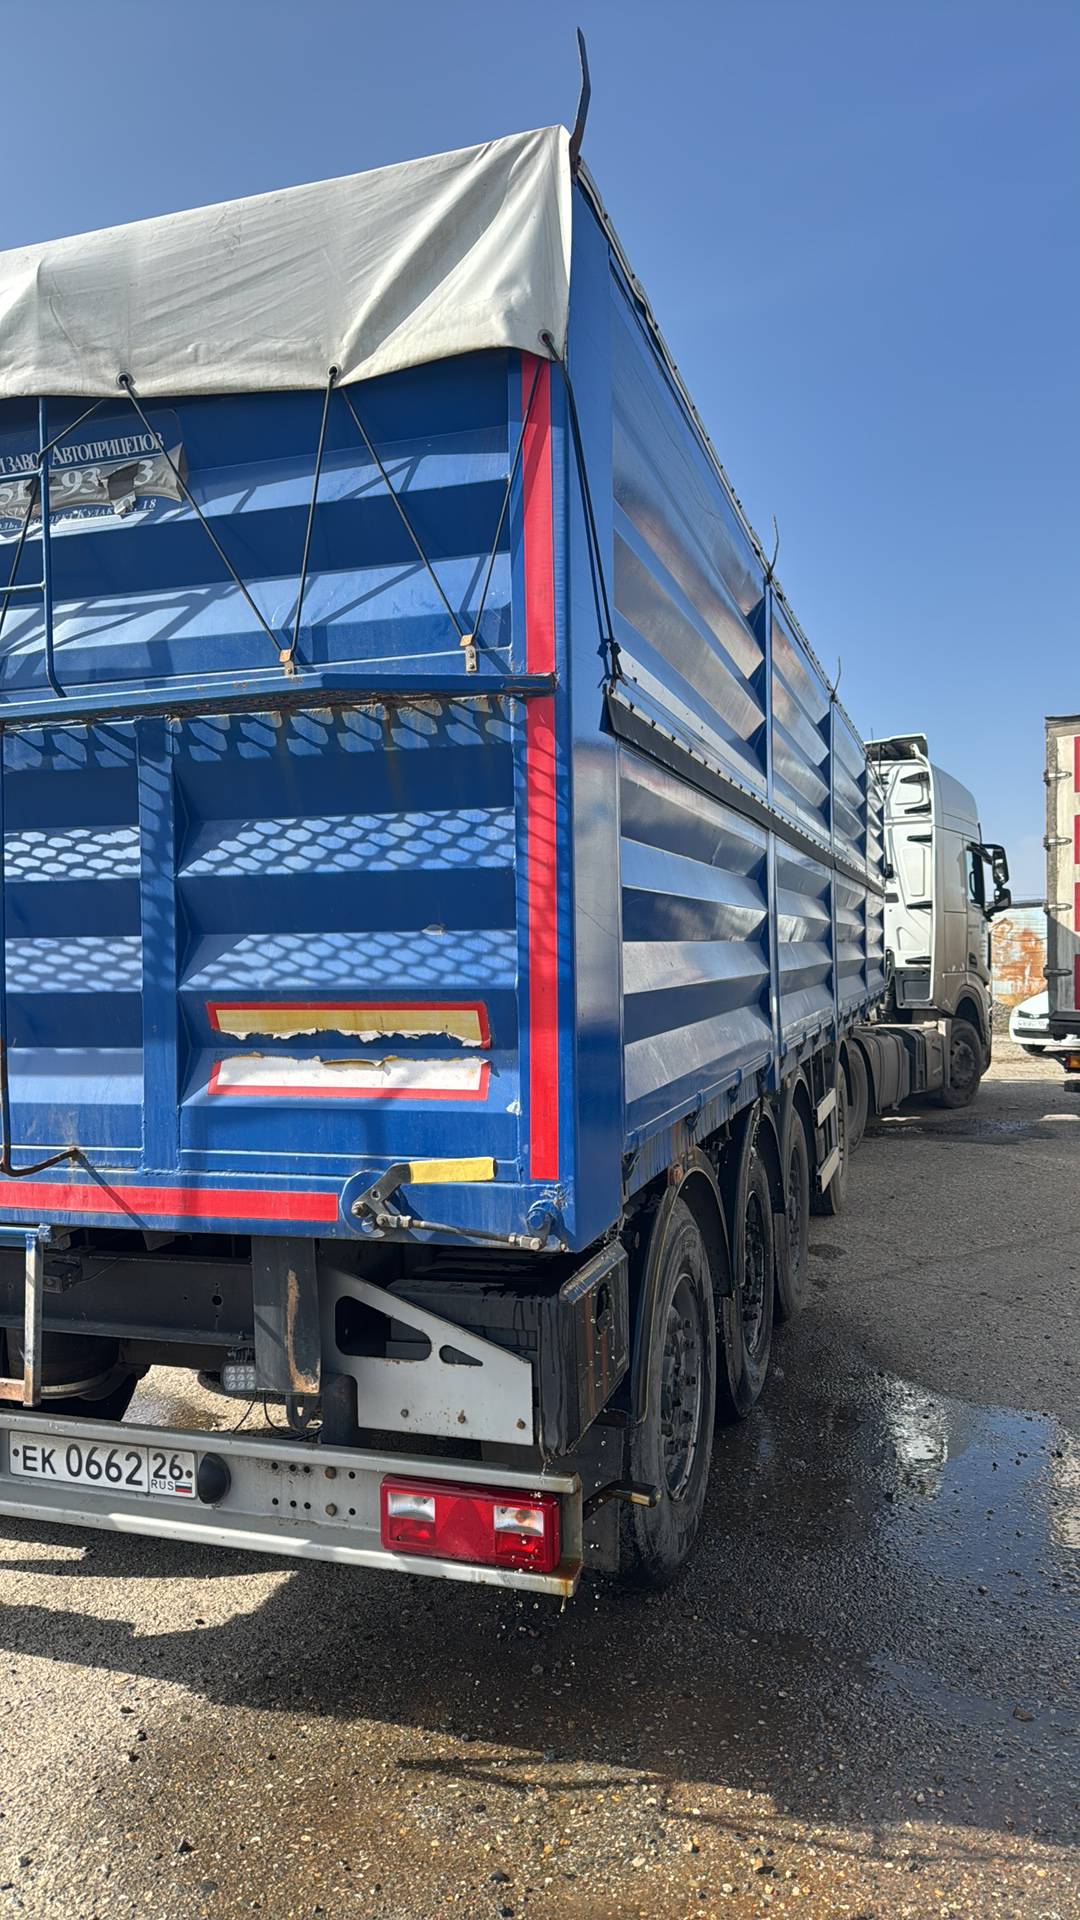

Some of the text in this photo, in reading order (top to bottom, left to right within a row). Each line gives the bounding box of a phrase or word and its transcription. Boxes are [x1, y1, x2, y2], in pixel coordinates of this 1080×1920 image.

[142, 498, 157, 510] 18
[22, 1443, 184, 1487] ЕК 0662 26
[150, 1478, 175, 1491] RUS
